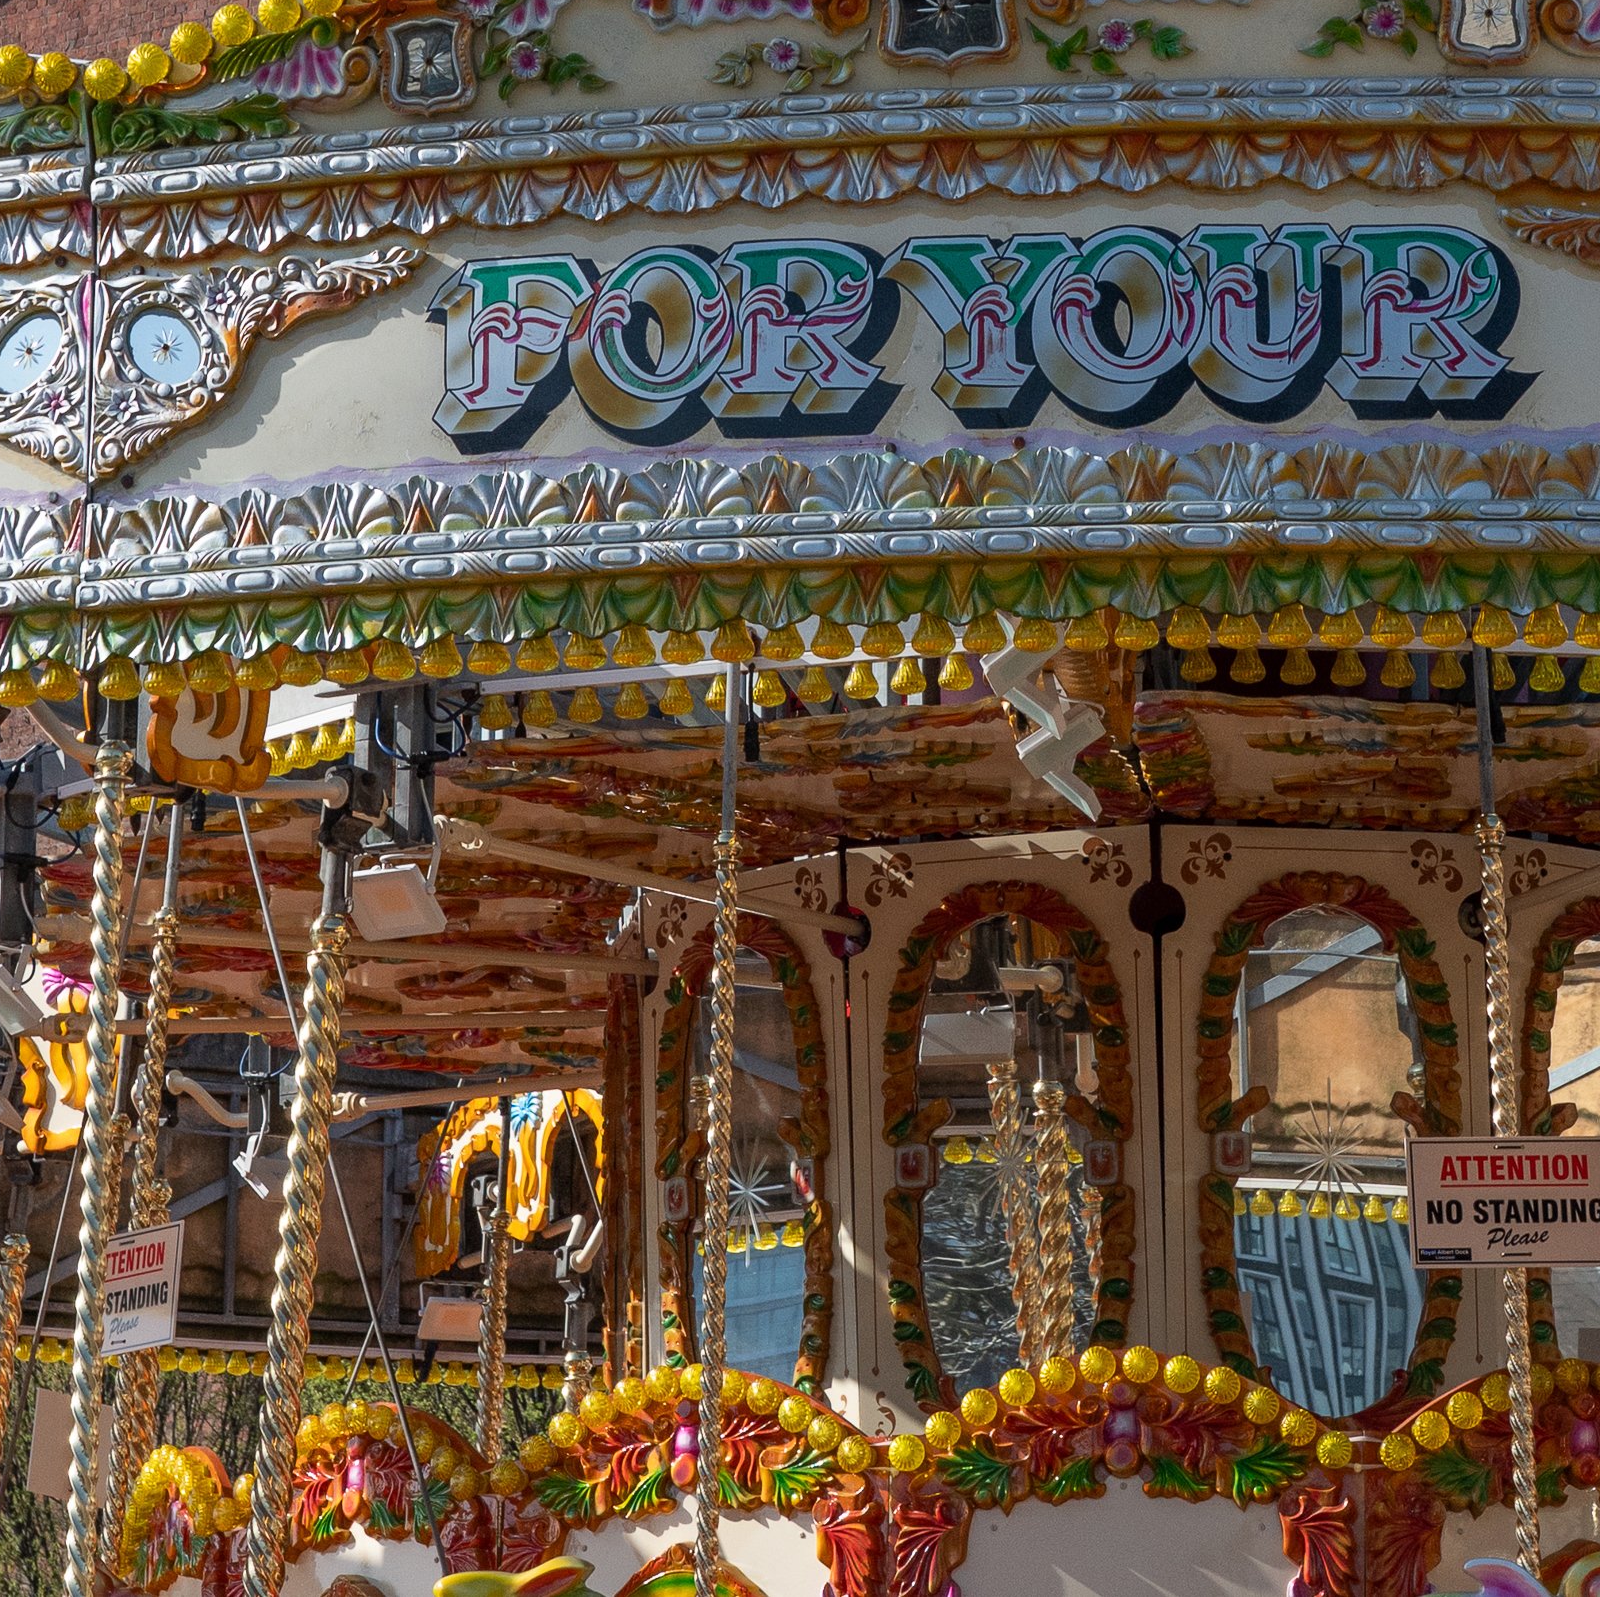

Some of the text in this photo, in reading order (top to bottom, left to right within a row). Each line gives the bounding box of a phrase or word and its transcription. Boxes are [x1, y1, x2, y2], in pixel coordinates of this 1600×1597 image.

[426, 221, 1545, 456] FOR YOUR
[1440, 1154, 1589, 1181] ATTENTION
[1427, 1200, 1463, 1225] NO
[1487, 1227, 1550, 1250] Please
[106, 1241, 165, 1276] TENTION
[105, 1281, 168, 1315] STANDING
